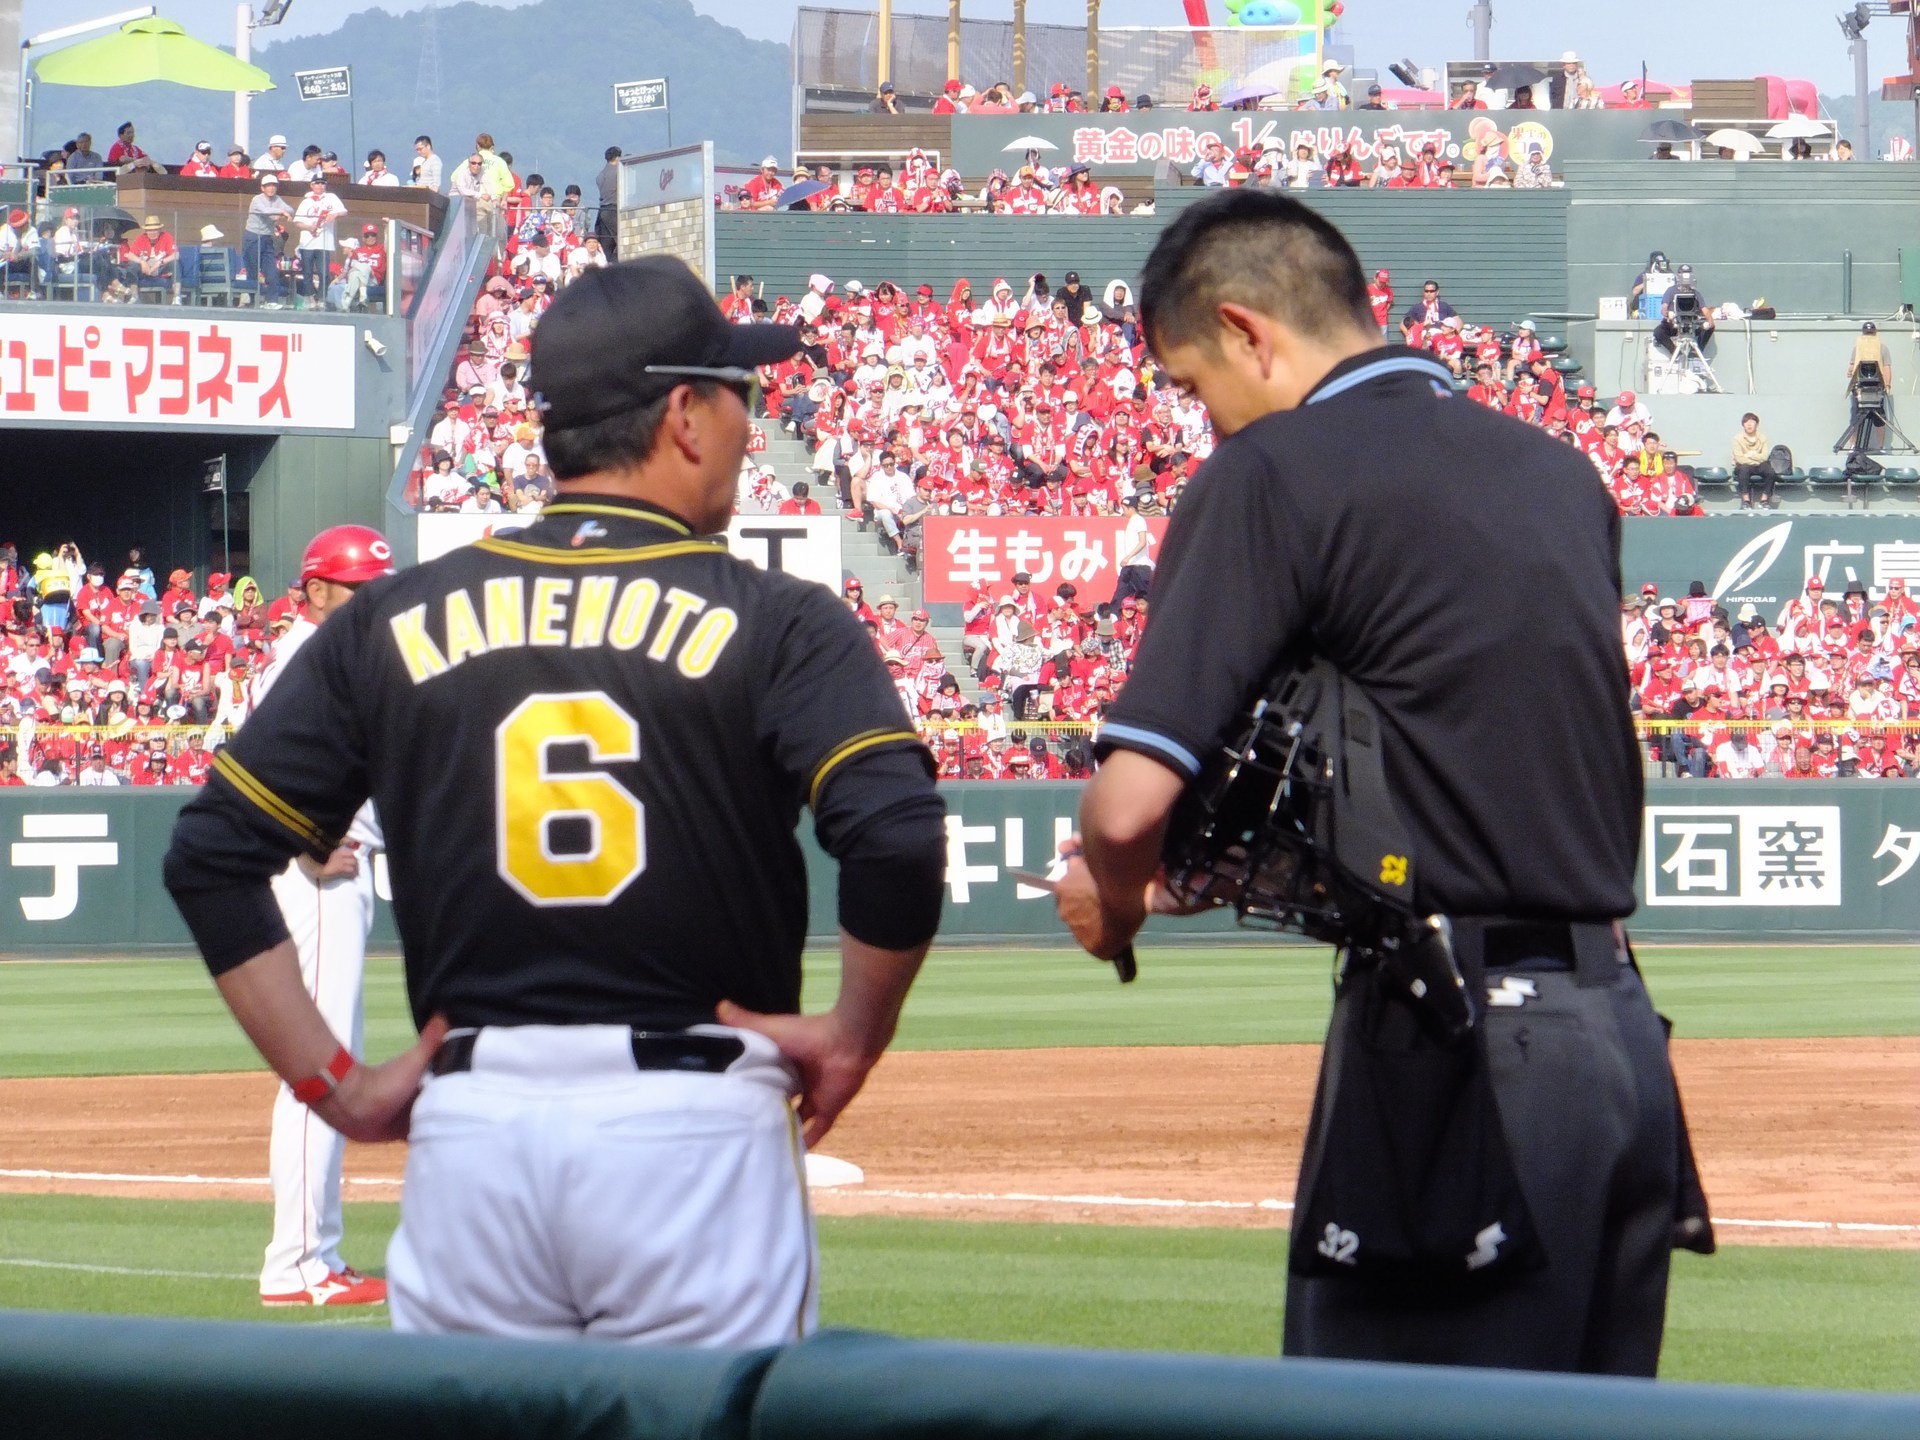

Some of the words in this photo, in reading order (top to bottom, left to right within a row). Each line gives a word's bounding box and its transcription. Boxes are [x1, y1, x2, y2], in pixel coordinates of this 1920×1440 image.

[0, 325, 302, 418] ューピーマヨネーズ
[389, 575, 739, 685] KANEMOTO
[496, 691, 647, 907] 6
[1379, 854, 1409, 886] 32
[1661, 820, 1826, 891] 石窯
[1317, 1222, 1360, 1266] 32
